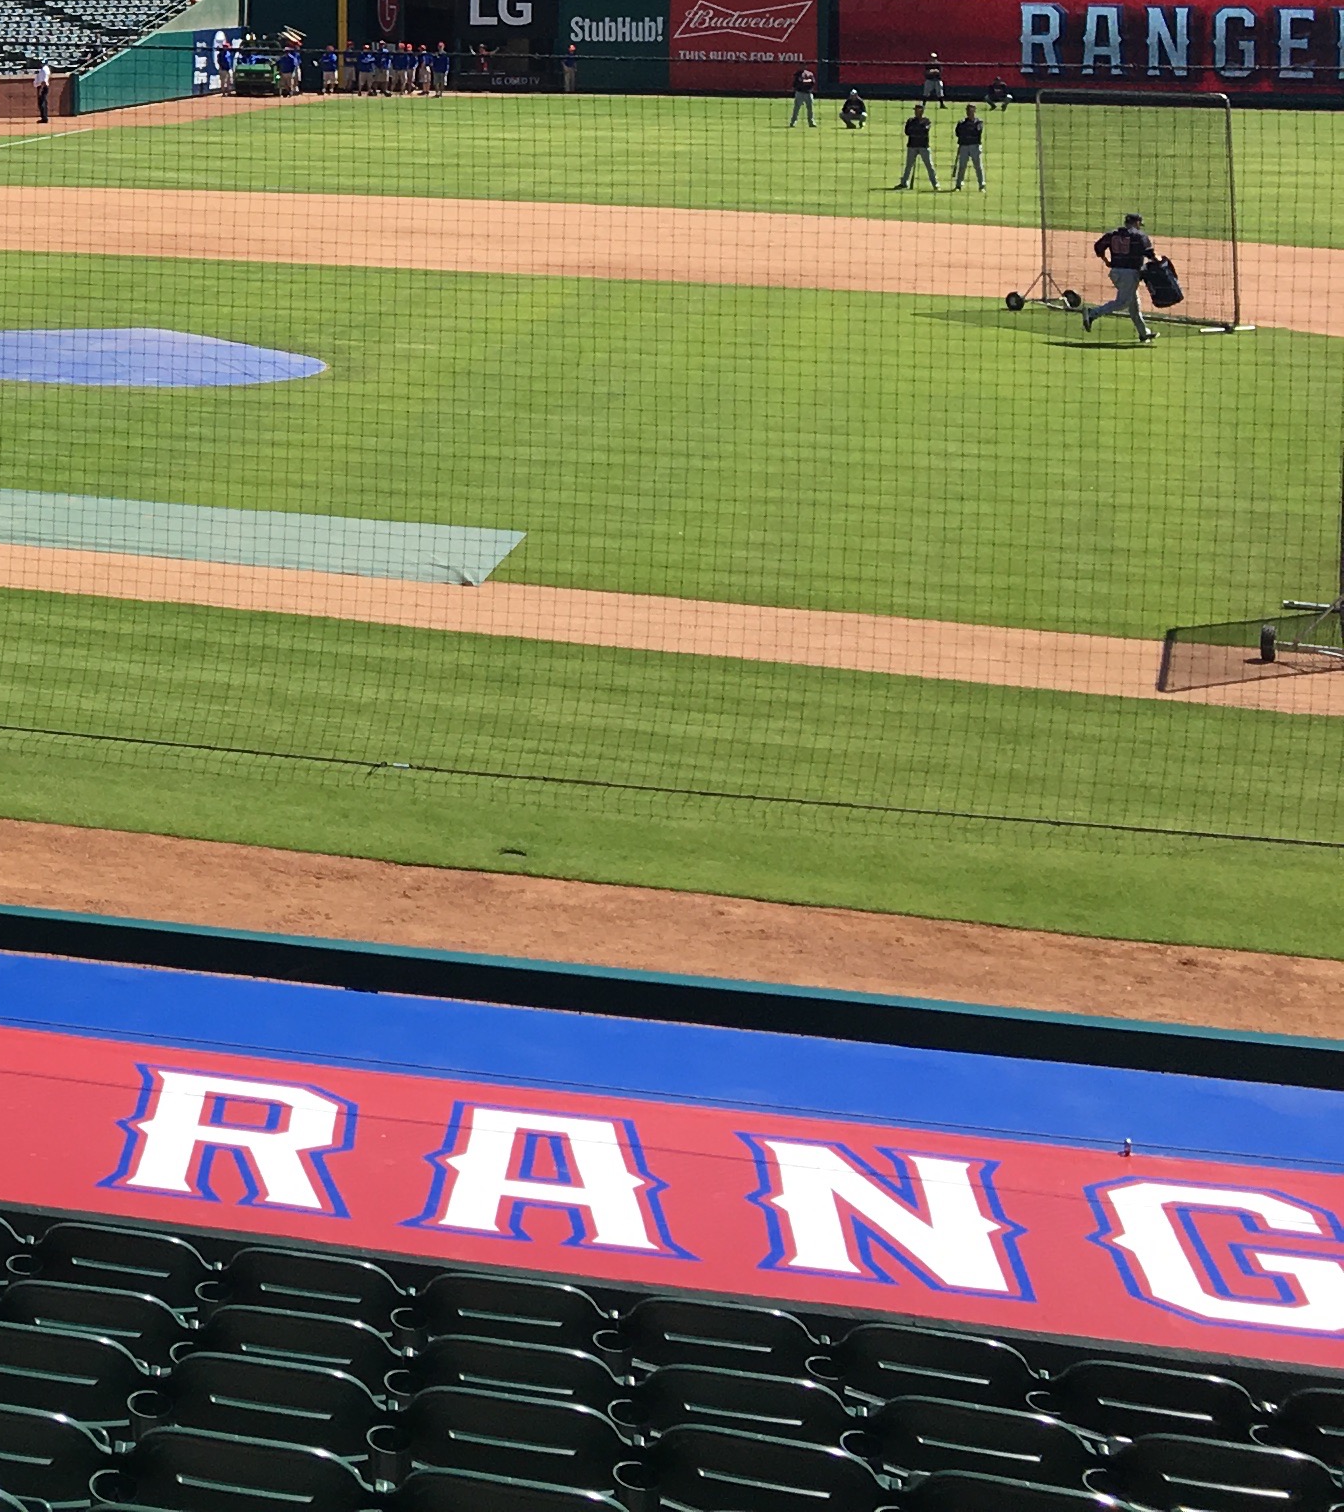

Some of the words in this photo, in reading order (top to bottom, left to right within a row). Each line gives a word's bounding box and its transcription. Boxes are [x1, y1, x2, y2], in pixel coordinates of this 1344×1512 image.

[570, 16, 664, 43] StubHub!
[684, 8, 796, 30] Budweiser
[1020, 1, 1344, 78] RANGE
[678, 50, 707, 61] THIS
